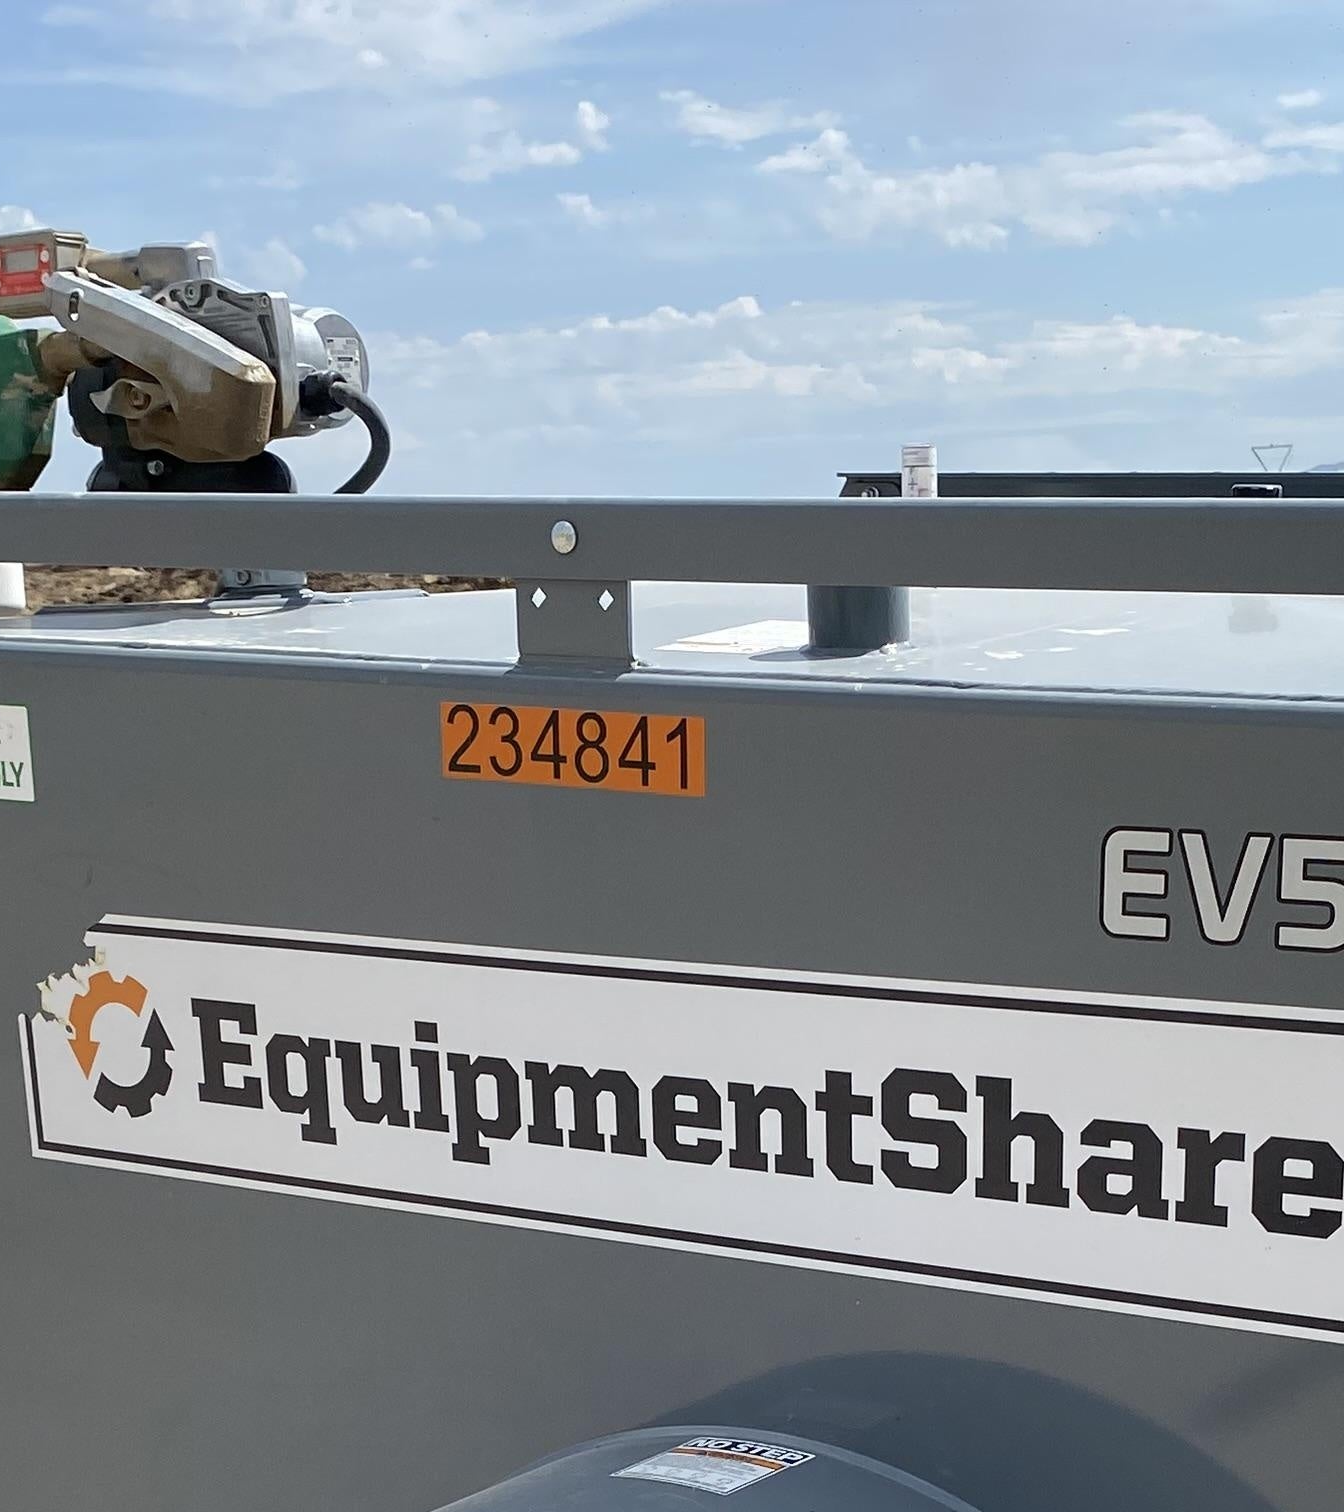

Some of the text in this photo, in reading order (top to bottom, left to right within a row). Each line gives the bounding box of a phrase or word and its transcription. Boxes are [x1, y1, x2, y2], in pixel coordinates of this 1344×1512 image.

[446, 703, 692, 792] 234841
[690, 1438, 727, 1449] NO
[734, 1442, 805, 1465] STEP
